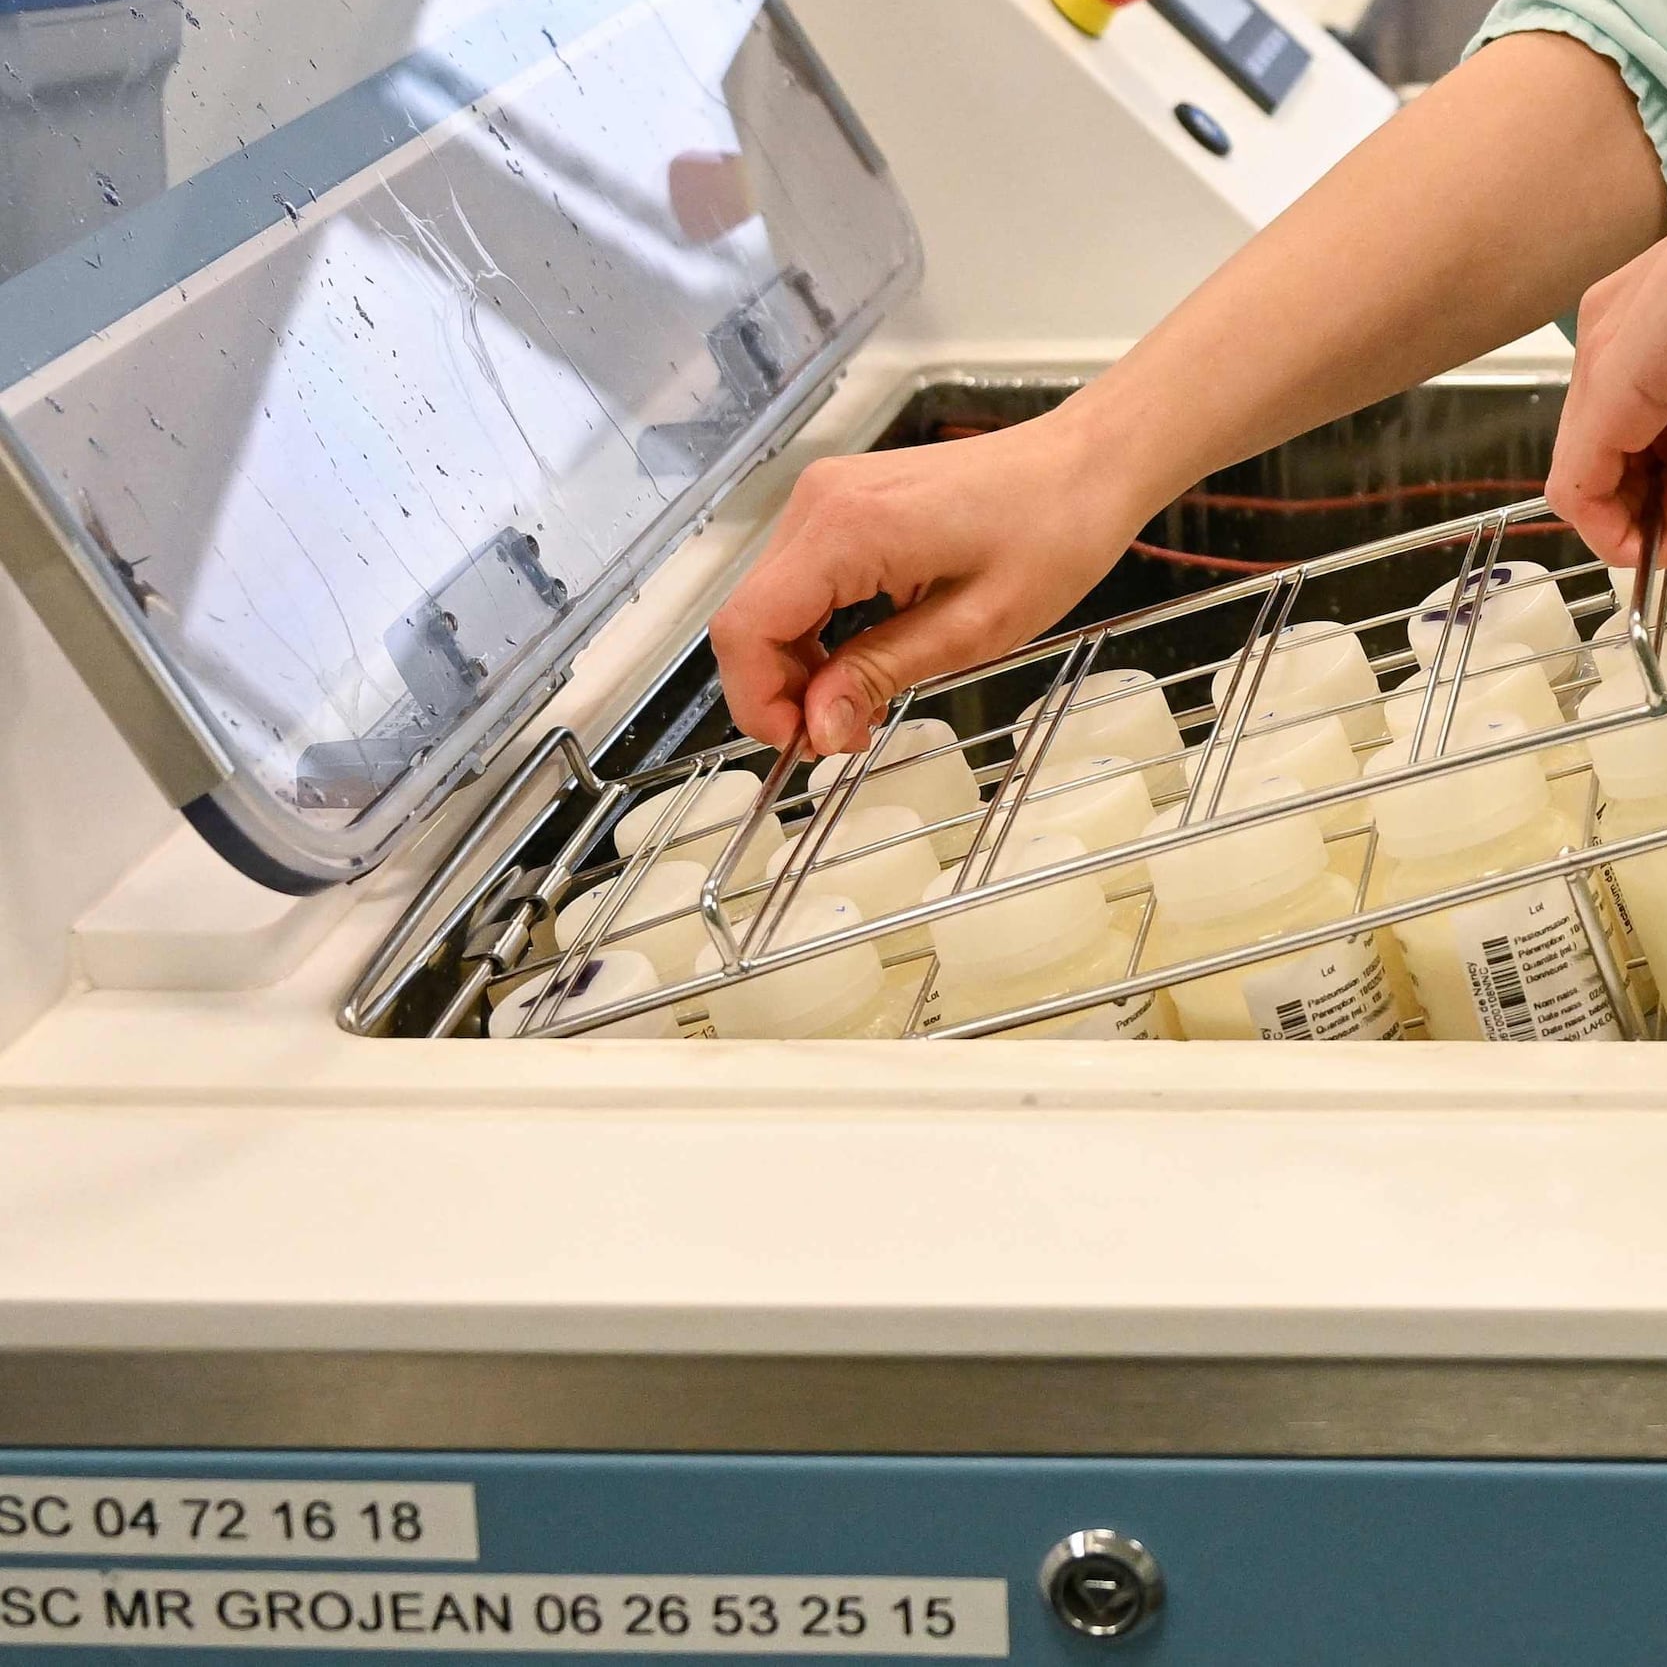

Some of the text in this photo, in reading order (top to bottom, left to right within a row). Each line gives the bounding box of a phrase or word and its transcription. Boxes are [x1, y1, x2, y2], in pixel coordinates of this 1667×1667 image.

[1321, 964, 1336, 978] Lot
[1466, 961, 1482, 997] Nancy
[1533, 997, 1556, 1011] Nom
[1538, 1012, 1559, 1024] Date
[1541, 1024, 1563, 1037] Date
[94, 1496, 159, 1538] 04
[180, 1499, 248, 1540] 72
[272, 1501, 337, 1542] 16
[360, 1502, 423, 1543] 18
[1, 1586, 957, 1638] SC MR GROJEAN 06 26 53 25 15
